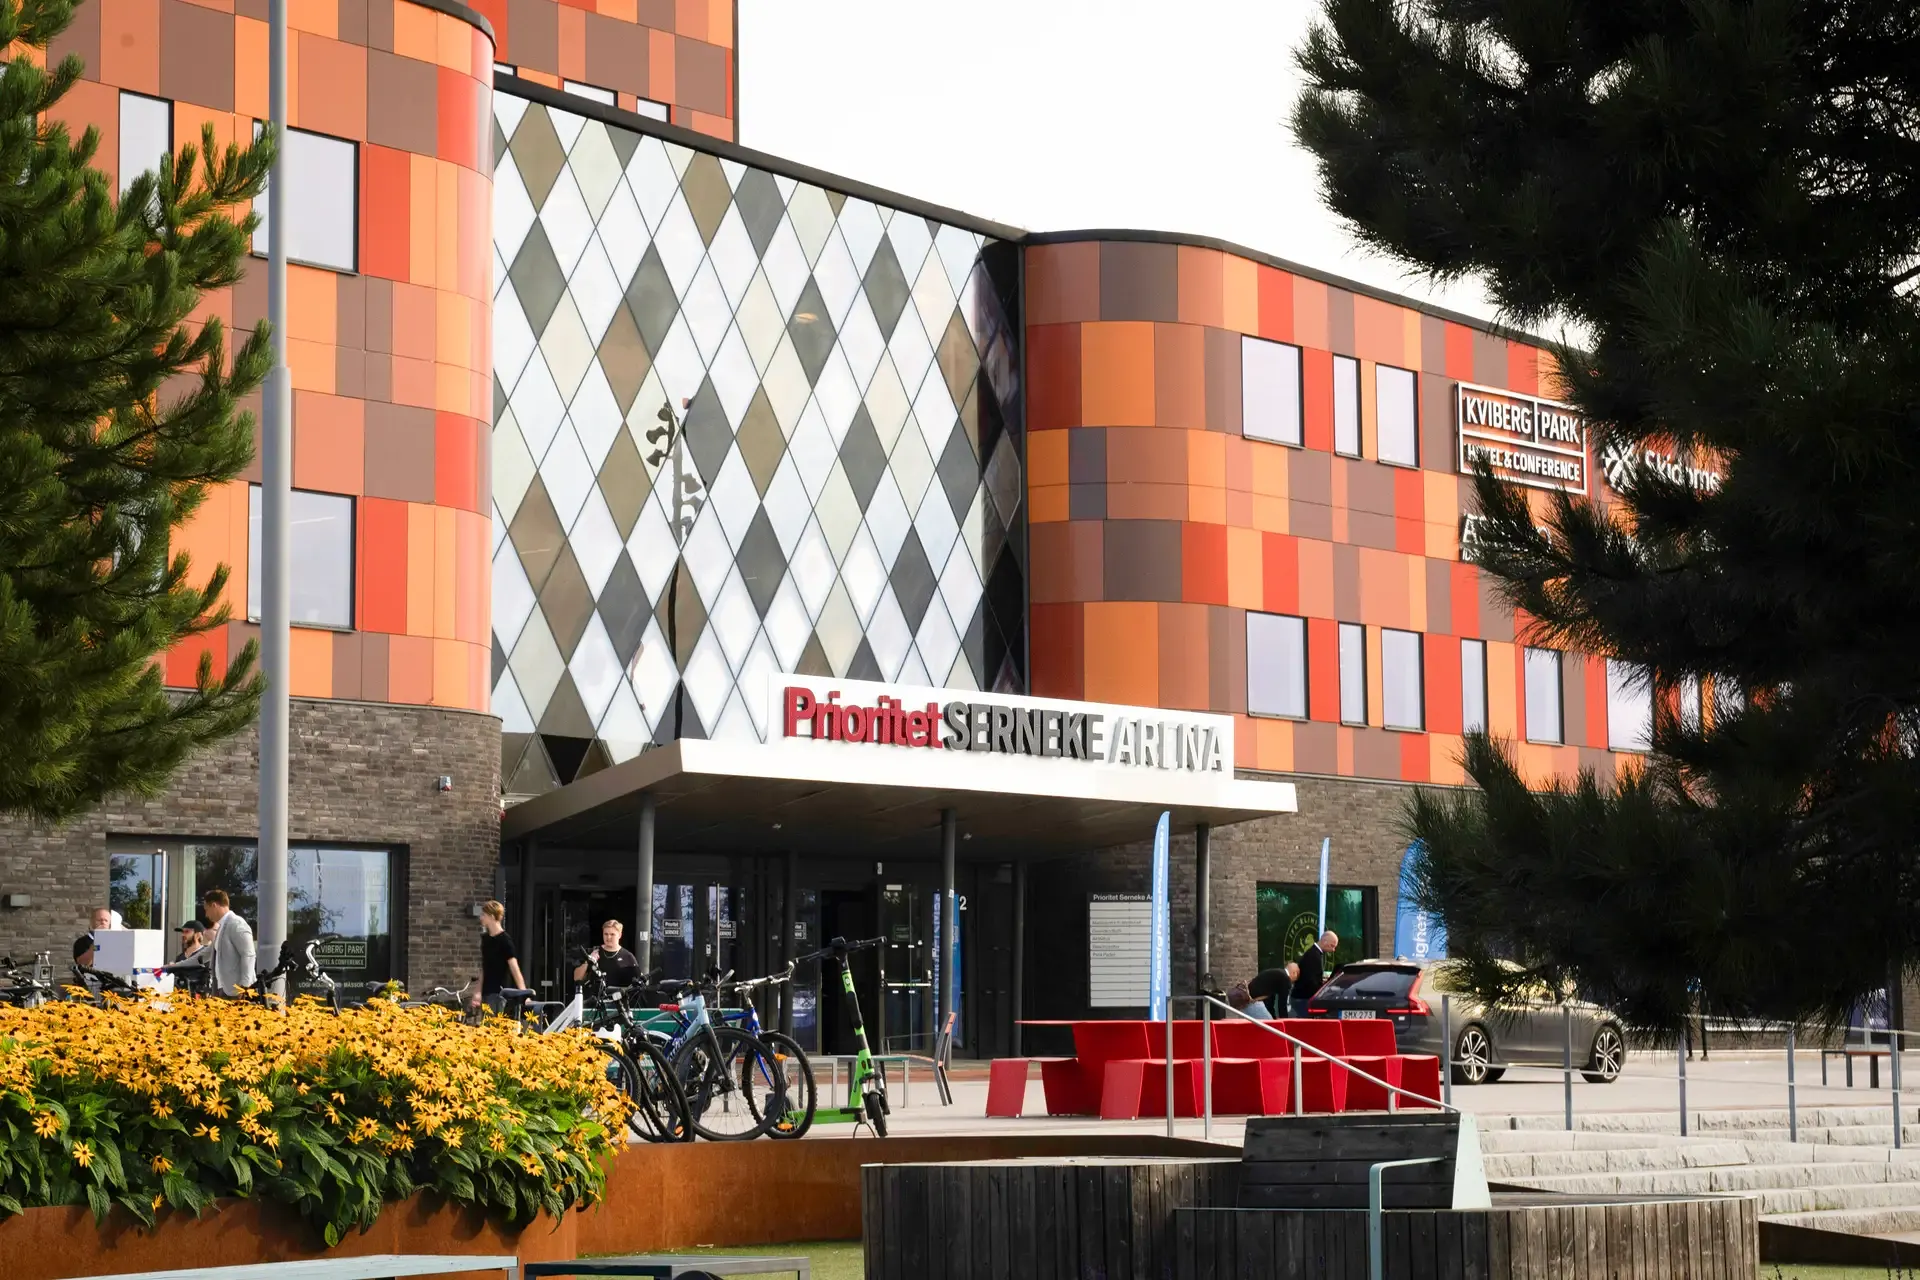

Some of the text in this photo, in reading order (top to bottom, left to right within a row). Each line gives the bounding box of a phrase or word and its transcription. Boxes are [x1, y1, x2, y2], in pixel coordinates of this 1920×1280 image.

[1464, 396, 1580, 444] KVIBERG PARK
[959, 895, 968, 911] 2
[347, 945, 365, 954] PARK
